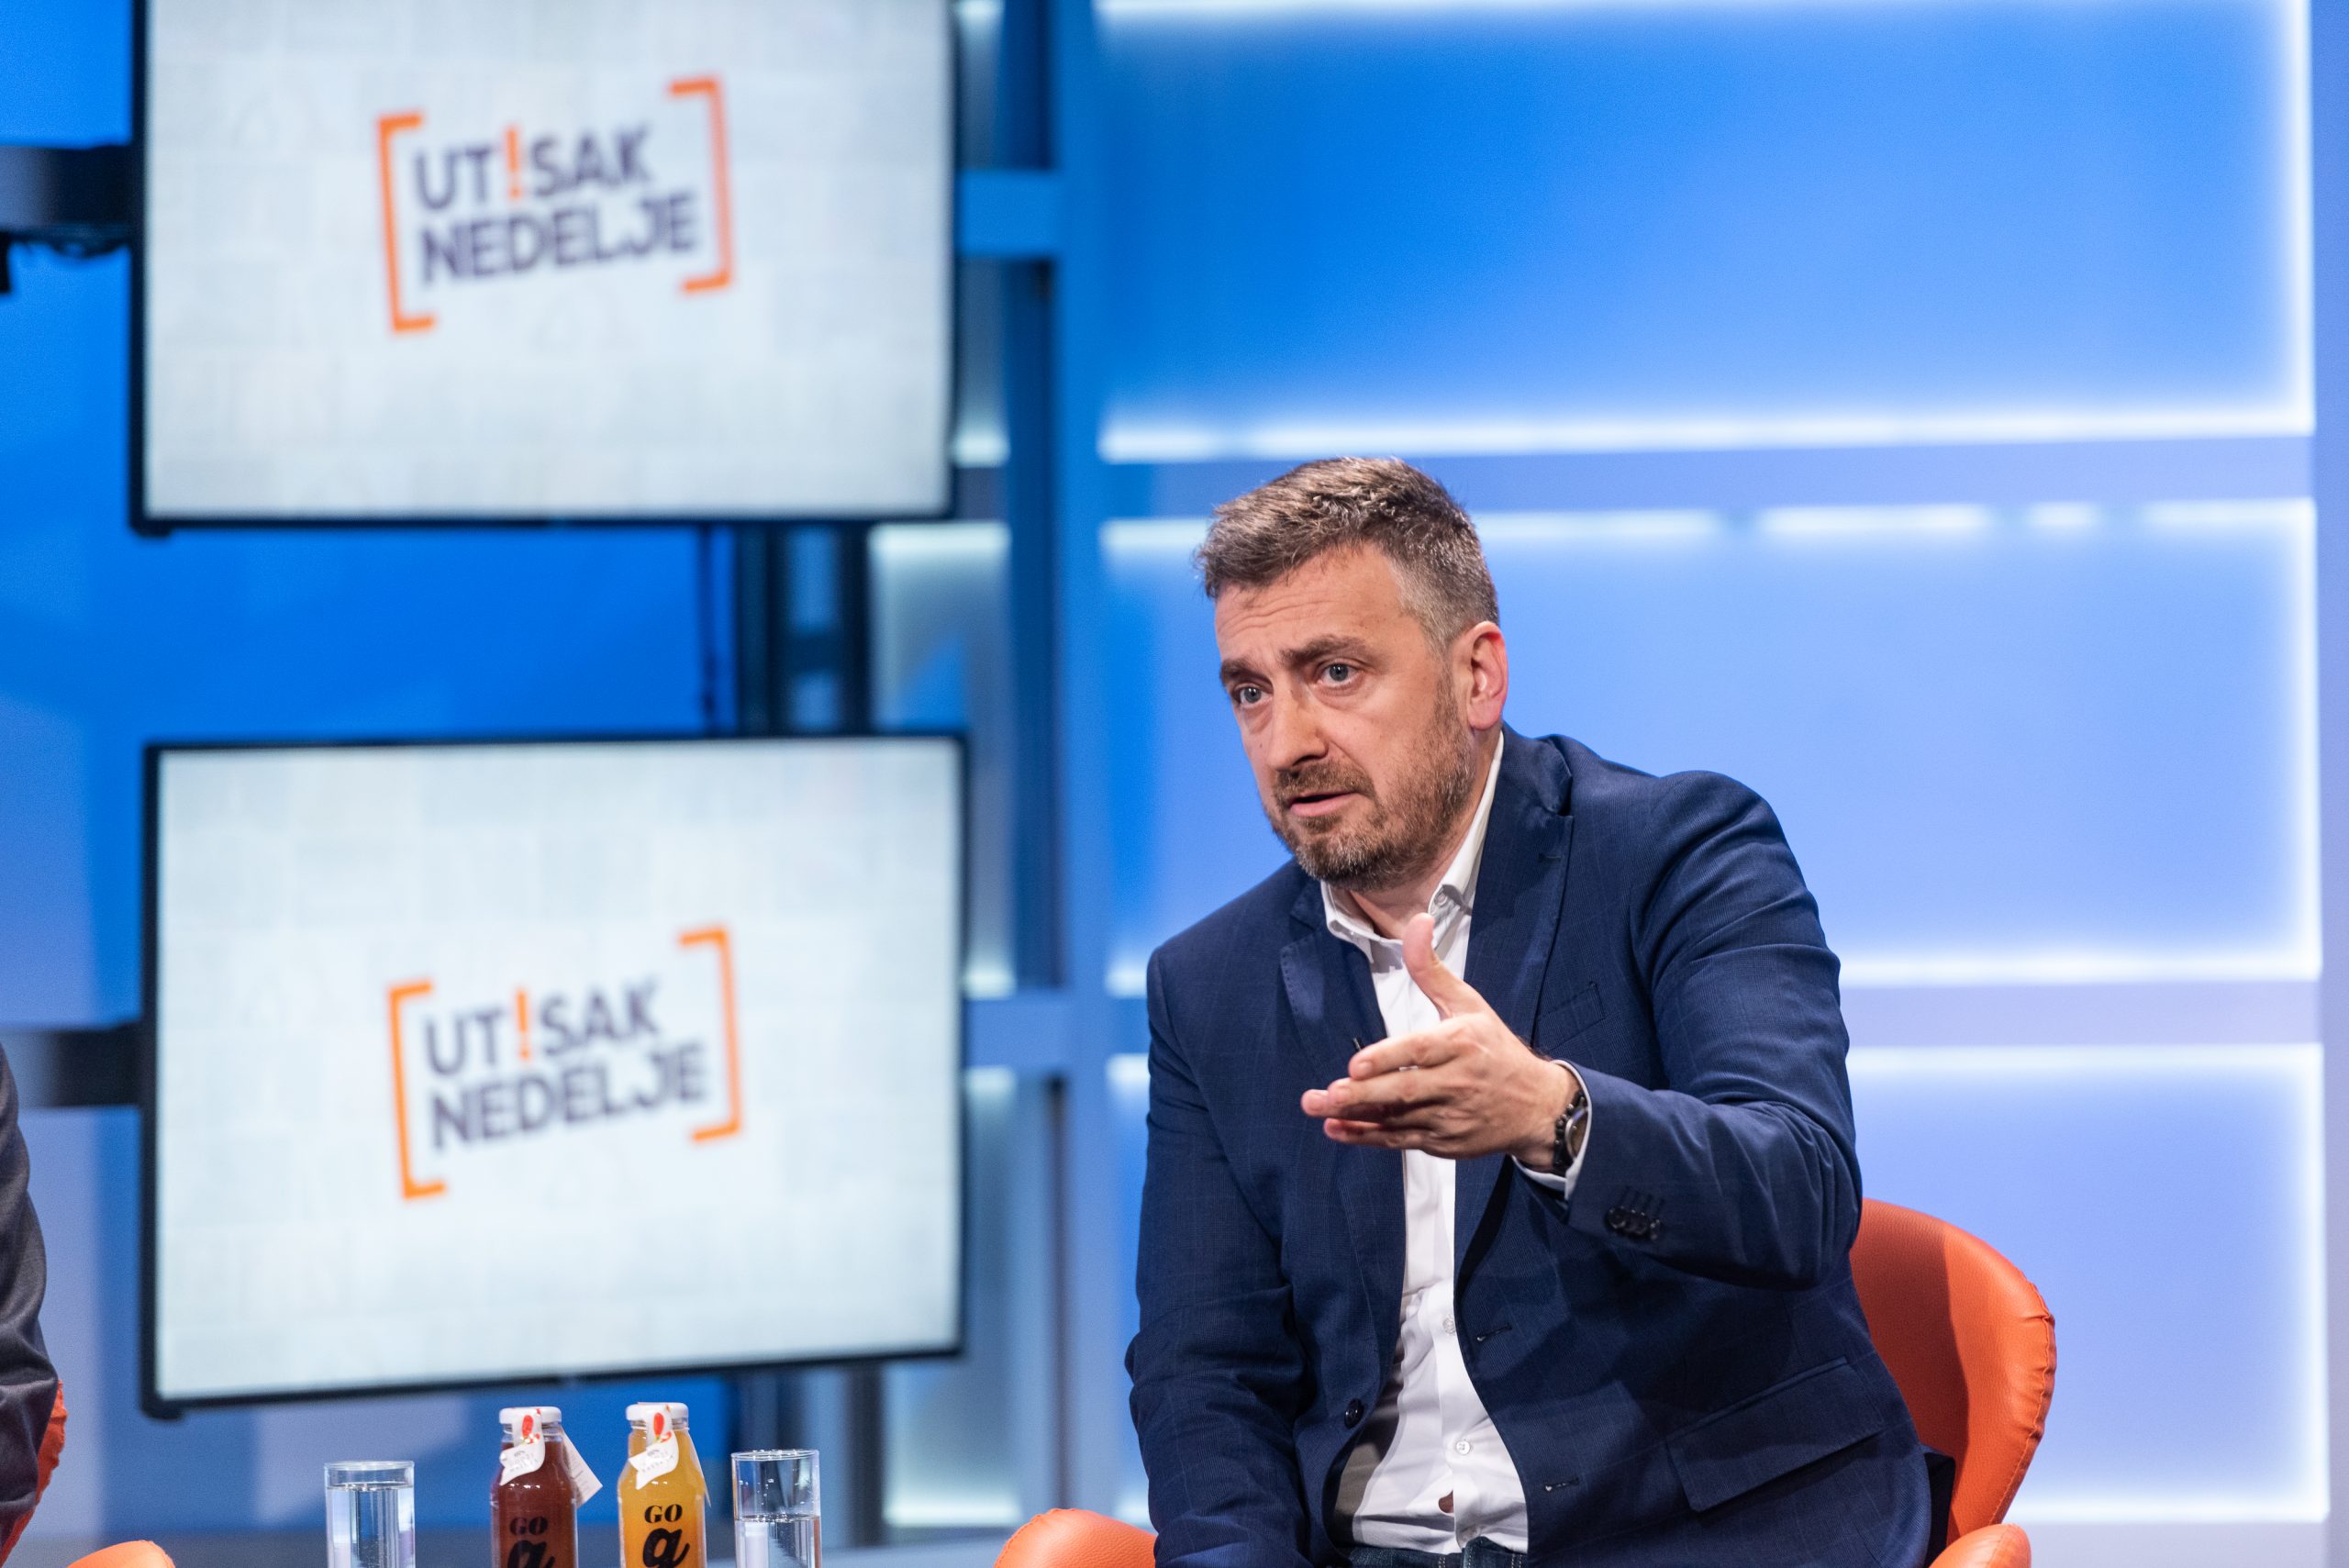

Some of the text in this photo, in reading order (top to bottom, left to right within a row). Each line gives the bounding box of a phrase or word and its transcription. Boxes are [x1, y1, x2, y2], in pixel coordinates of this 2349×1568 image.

[420, 190, 699, 287] NEDELJE
[432, 1042, 706, 1151] NEDELJE
[509, 1516, 548, 1535] GO
[644, 1503, 683, 1523] GO
